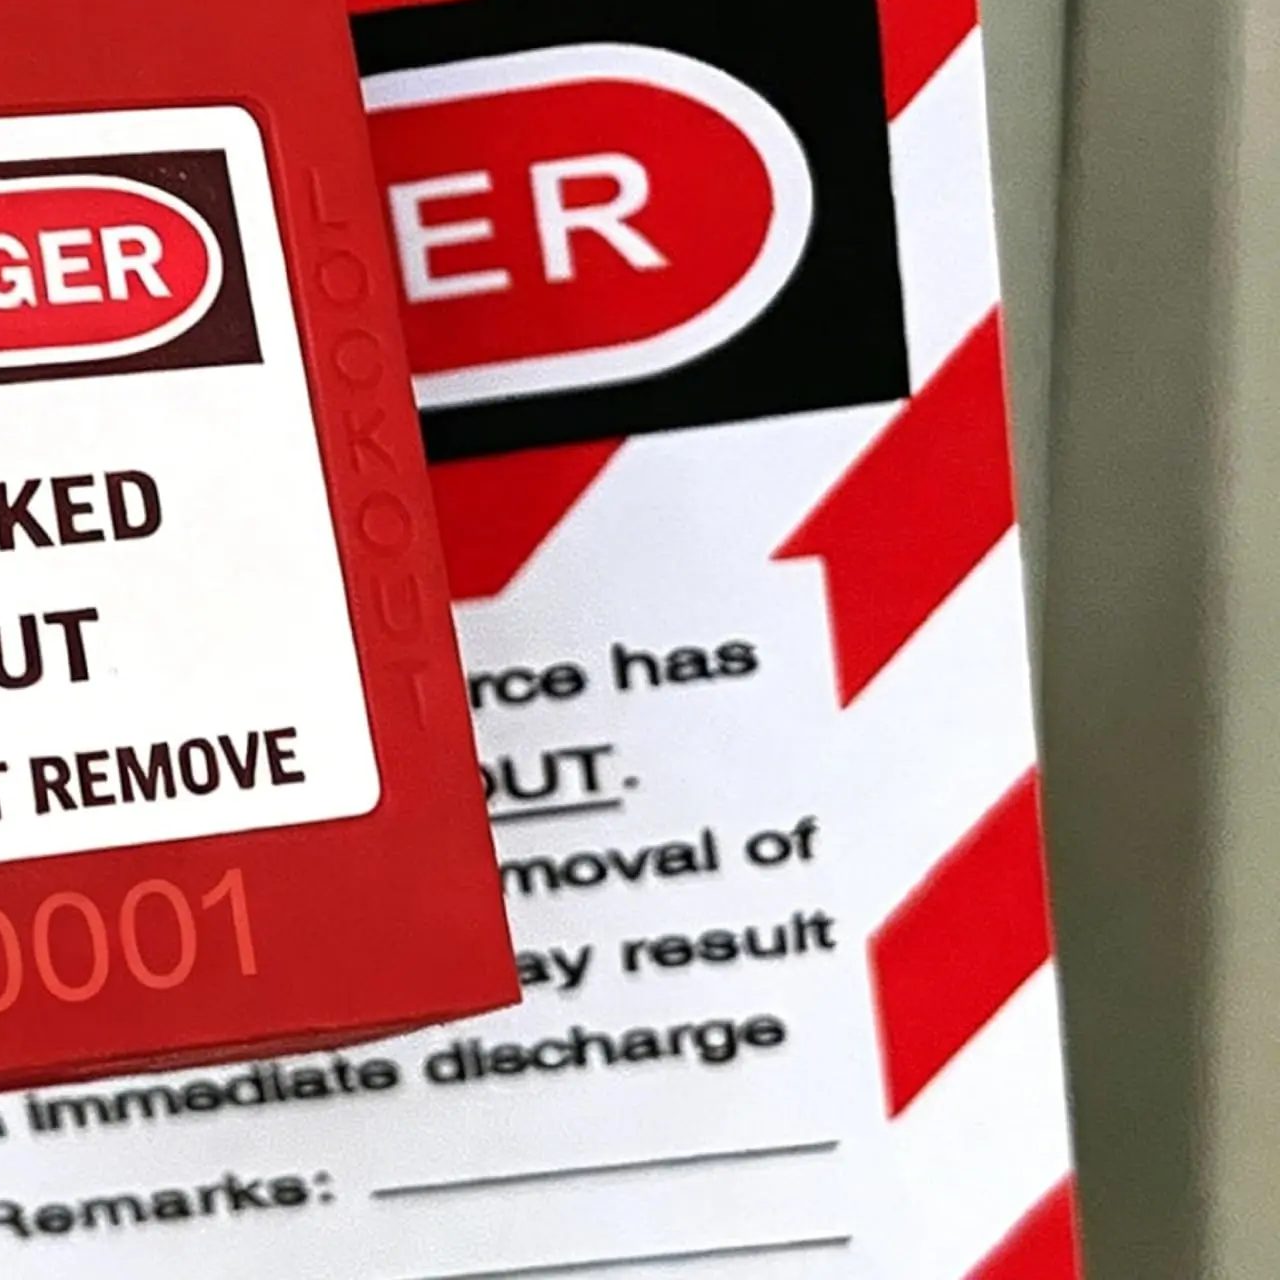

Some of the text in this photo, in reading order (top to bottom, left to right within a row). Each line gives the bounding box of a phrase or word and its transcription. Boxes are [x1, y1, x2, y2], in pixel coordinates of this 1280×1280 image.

[308, 167, 430, 731] LOCKOUT
[610, 639, 759, 692] has
[30, 727, 305, 815] REMOVE
[744, 816, 819, 867] of
[622, 909, 838, 973] result
[26, 1052, 397, 1134] immediate
[426, 1014, 786, 1086] discharge
